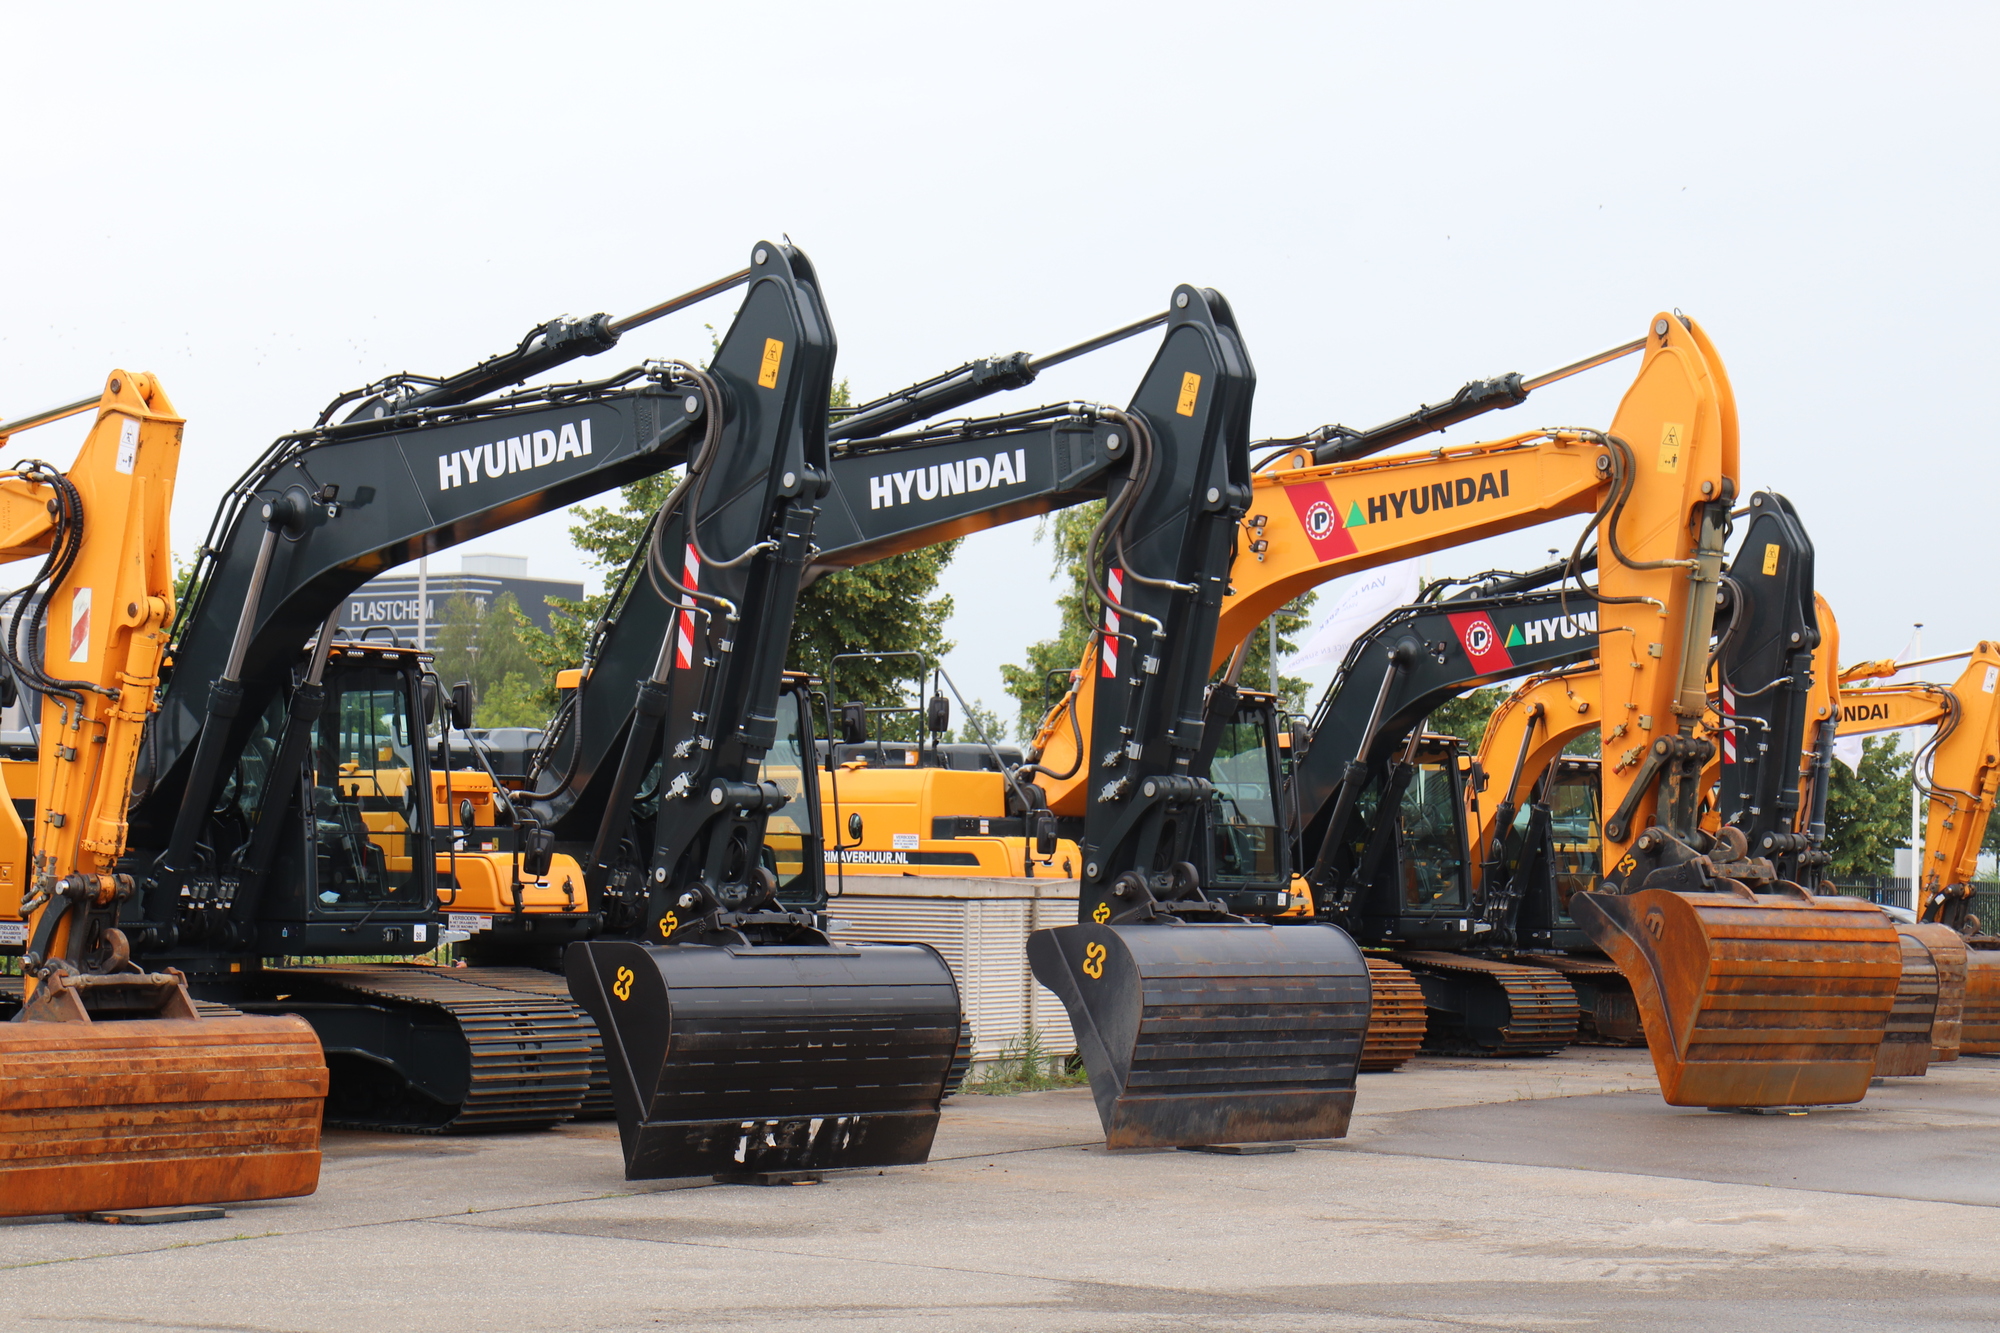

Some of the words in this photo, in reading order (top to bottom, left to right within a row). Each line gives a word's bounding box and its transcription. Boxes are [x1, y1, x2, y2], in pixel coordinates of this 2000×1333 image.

[438, 418, 593, 491] HYUNDAI
[869, 448, 1027, 510] HYUNDAI
[1314, 511, 1328, 531] P
[1367, 469, 1509, 524] HYUNDAI
[351, 599, 434, 622] PLASTCHEM
[1473, 630, 1486, 647] P
[1524, 610, 1598, 646] HYUN
[1836, 703, 1888, 722] NDAI
